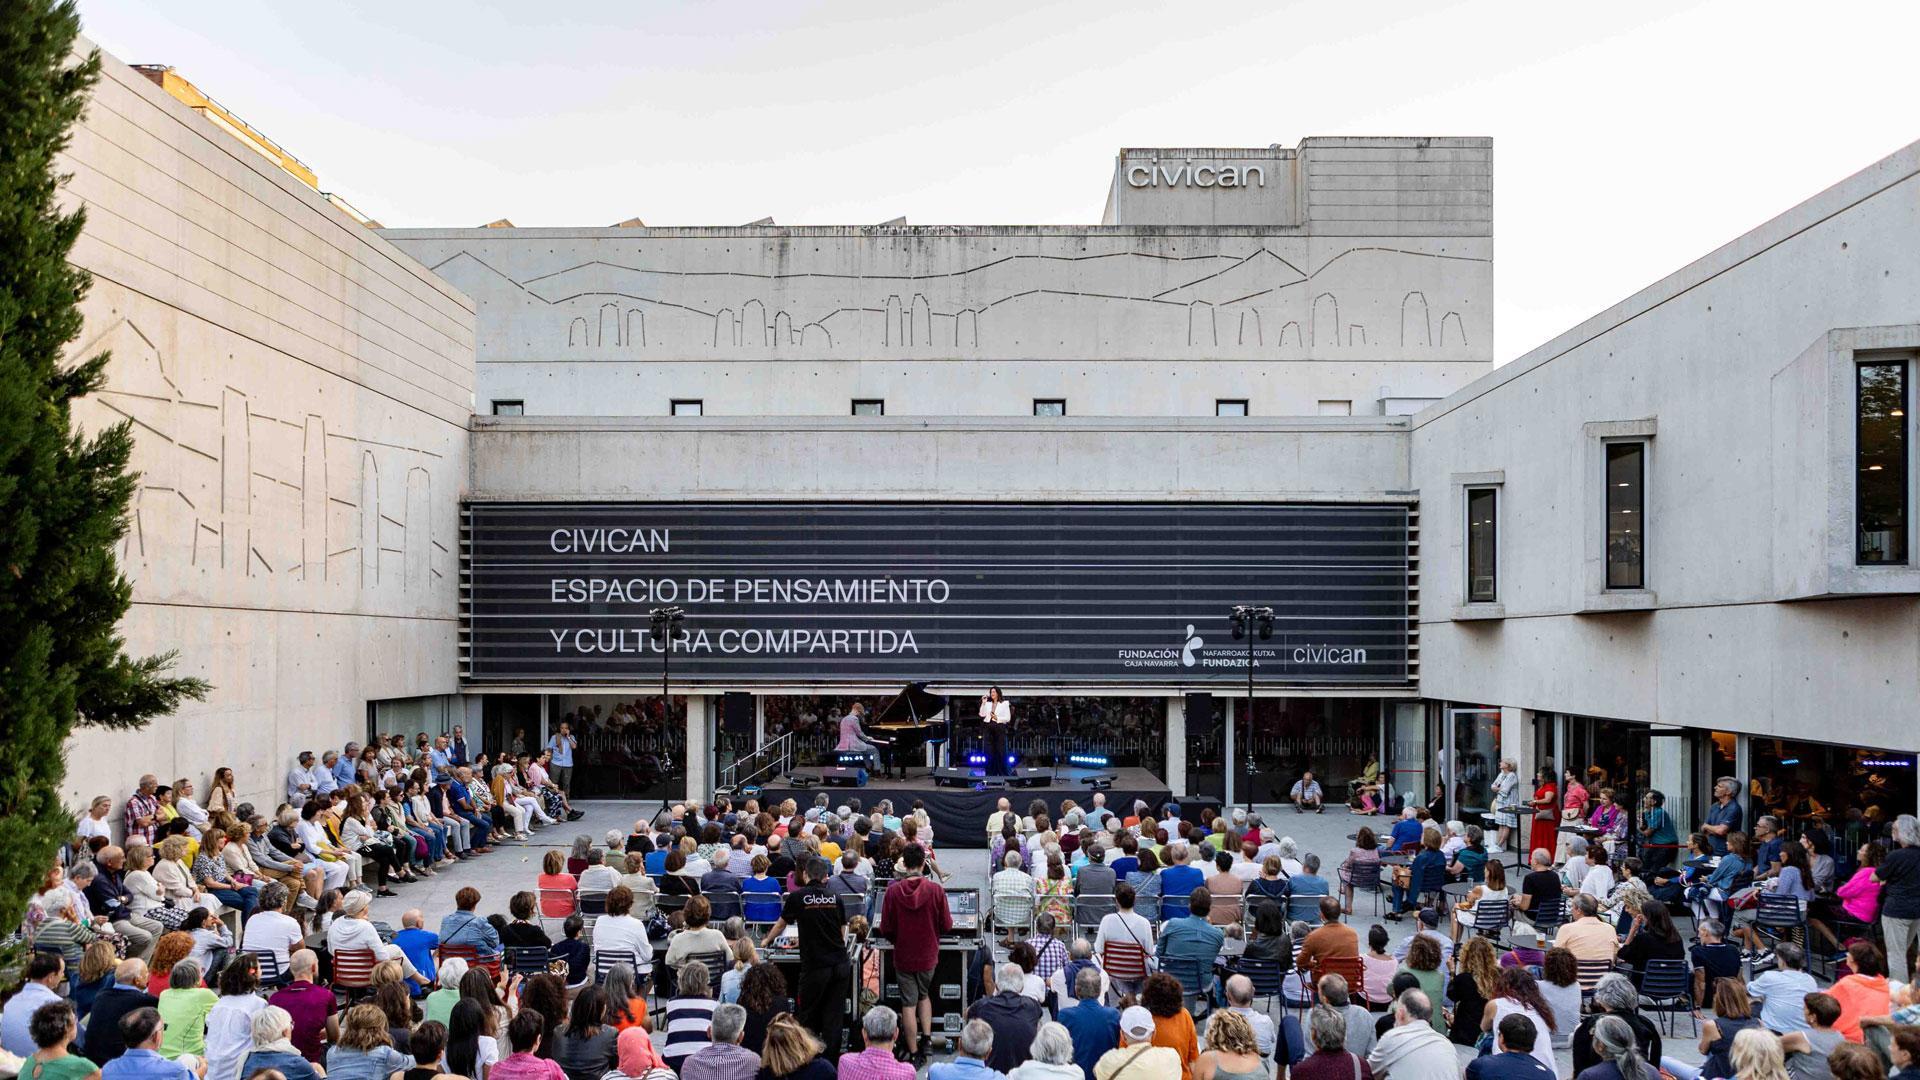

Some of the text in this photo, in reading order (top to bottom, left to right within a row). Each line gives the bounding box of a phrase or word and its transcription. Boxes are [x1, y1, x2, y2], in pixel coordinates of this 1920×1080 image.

[1127, 157, 1265, 187] civican
[550, 528, 670, 553] CIVICAN
[551, 579, 951, 604] ESPACIO DE PENSAMIENTO
[550, 629, 919, 654] Y CULTURA COMPARTIDA
[1118, 647, 1179, 659] FUNDACIÓN
[1293, 644, 1367, 664] civican
[803, 894, 836, 904] Global
